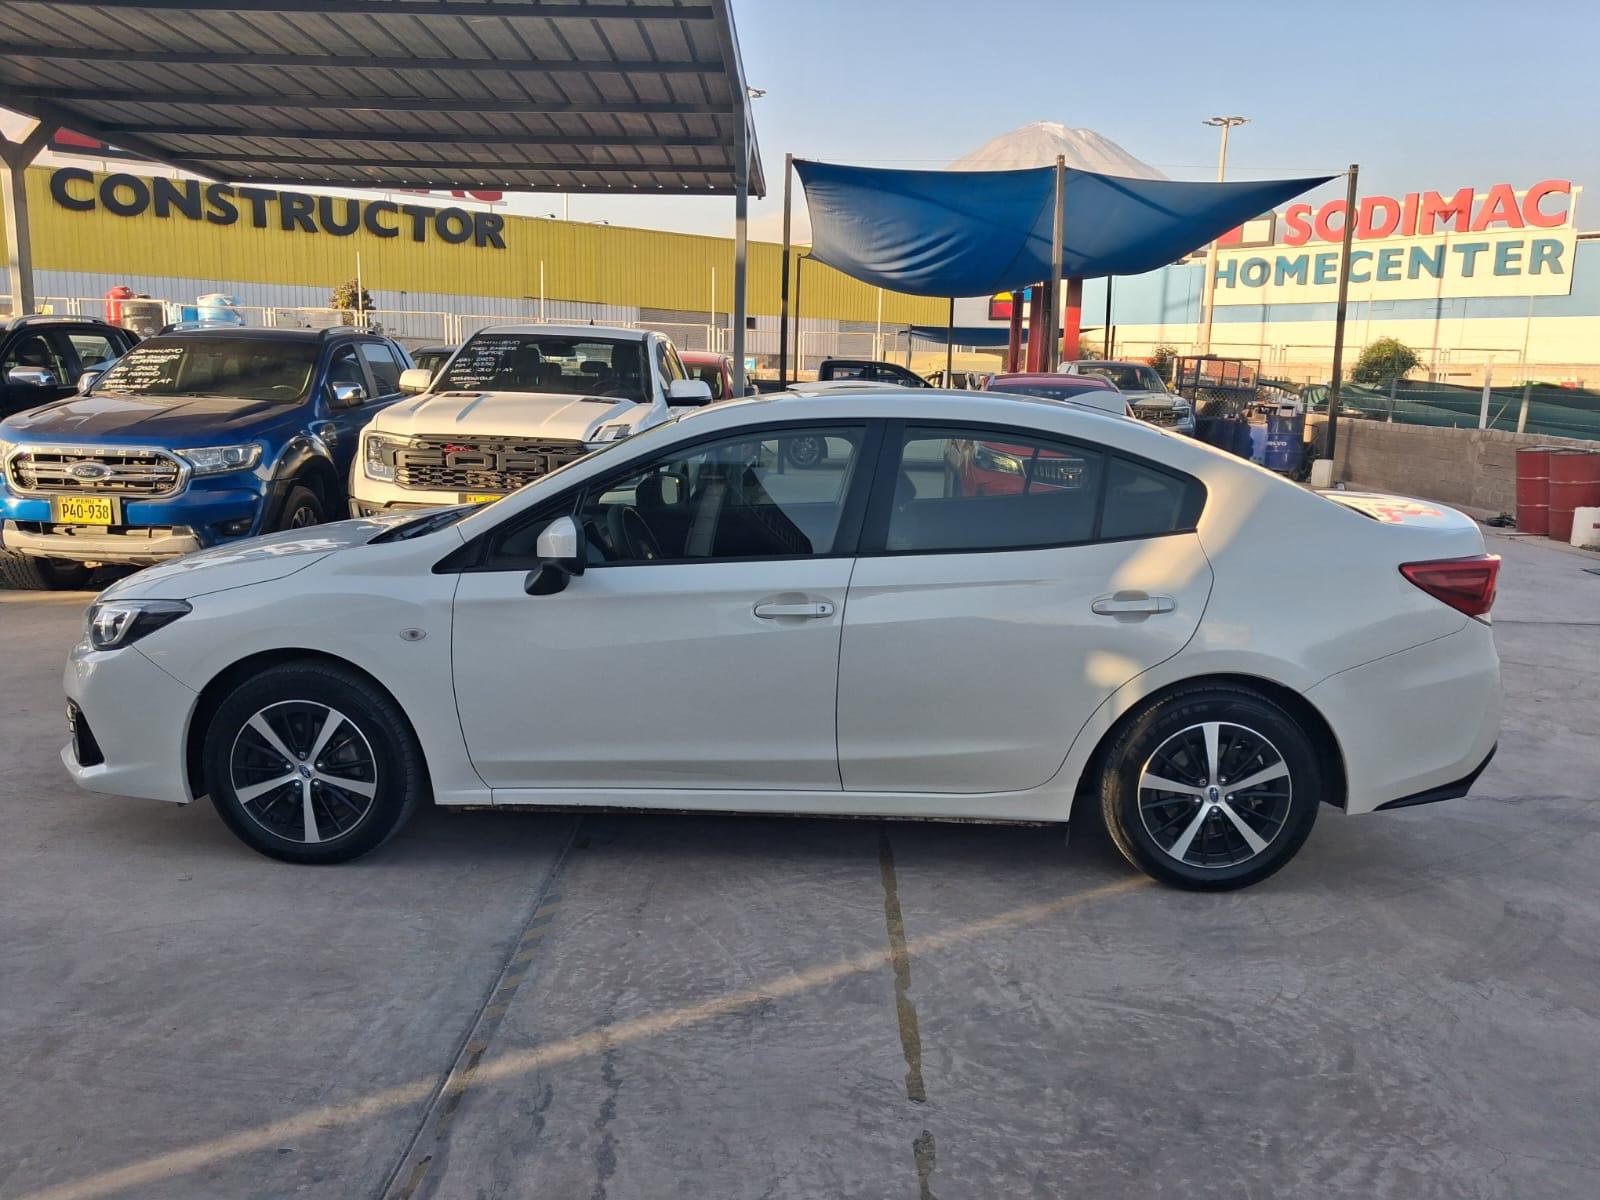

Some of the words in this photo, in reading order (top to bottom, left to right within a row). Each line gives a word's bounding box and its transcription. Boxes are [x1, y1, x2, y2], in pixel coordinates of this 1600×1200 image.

[50, 167, 506, 249] CONSTRUCTOR
[1283, 179, 1571, 246] SODIMAC
[62, 504, 110, 520] P40-938
